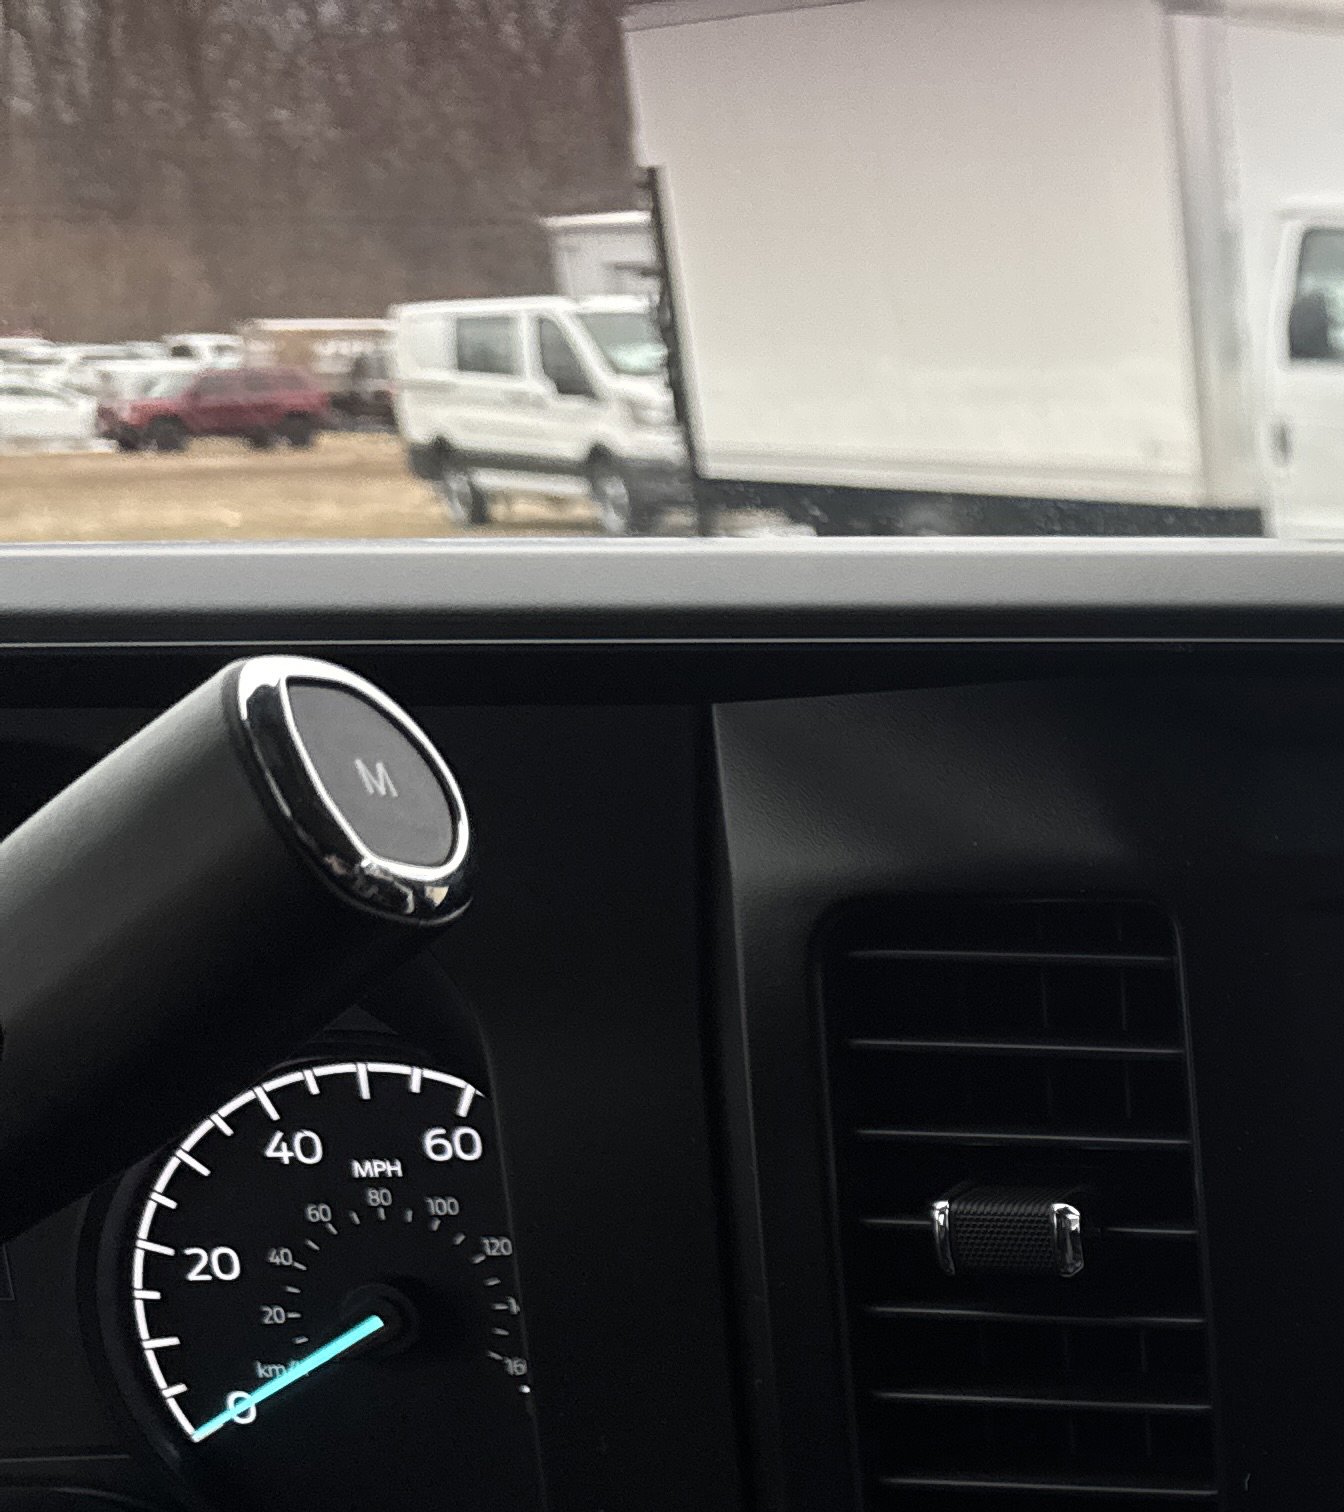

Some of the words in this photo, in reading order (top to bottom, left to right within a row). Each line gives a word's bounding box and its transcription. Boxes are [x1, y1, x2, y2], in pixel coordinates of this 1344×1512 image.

[355, 758, 398, 797] M
[264, 1129, 324, 1165] 40
[422, 1126, 483, 1162] 60
[351, 1159, 403, 1178] MPH
[366, 1187, 392, 1207] 80
[426, 1197, 460, 1217] 100
[306, 1202, 333, 1224] 60
[480, 1235, 513, 1256] 120
[184, 1247, 241, 1282] 20
[267, 1246, 294, 1267] 40
[261, 1306, 286, 1325] 20
[503, 1356, 529, 1377] 16
[226, 1390, 257, 1425] 0
